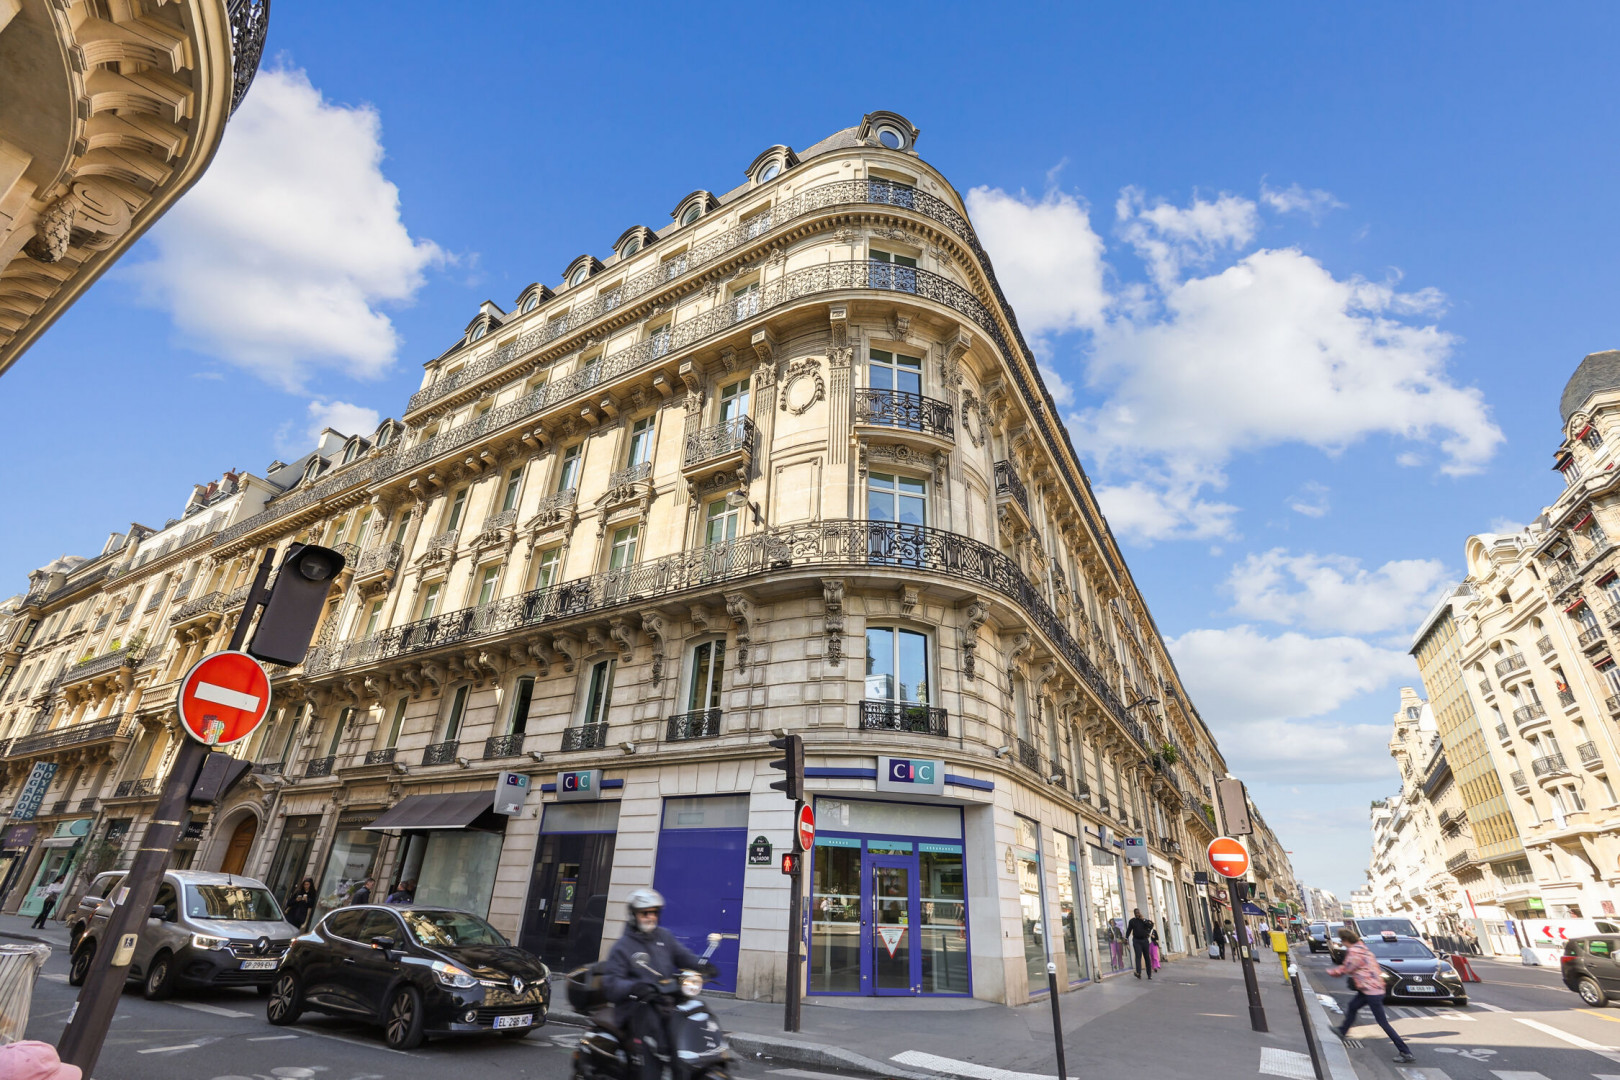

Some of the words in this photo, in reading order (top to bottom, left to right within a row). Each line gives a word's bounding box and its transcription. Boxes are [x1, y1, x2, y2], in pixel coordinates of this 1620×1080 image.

[893, 763, 930, 780] CIC
[508, 775, 525, 786] CIC
[565, 775, 588, 789] CIC
[13, 763, 46, 818] MOGADOR
[24, 764, 57, 818] VOYAGES
